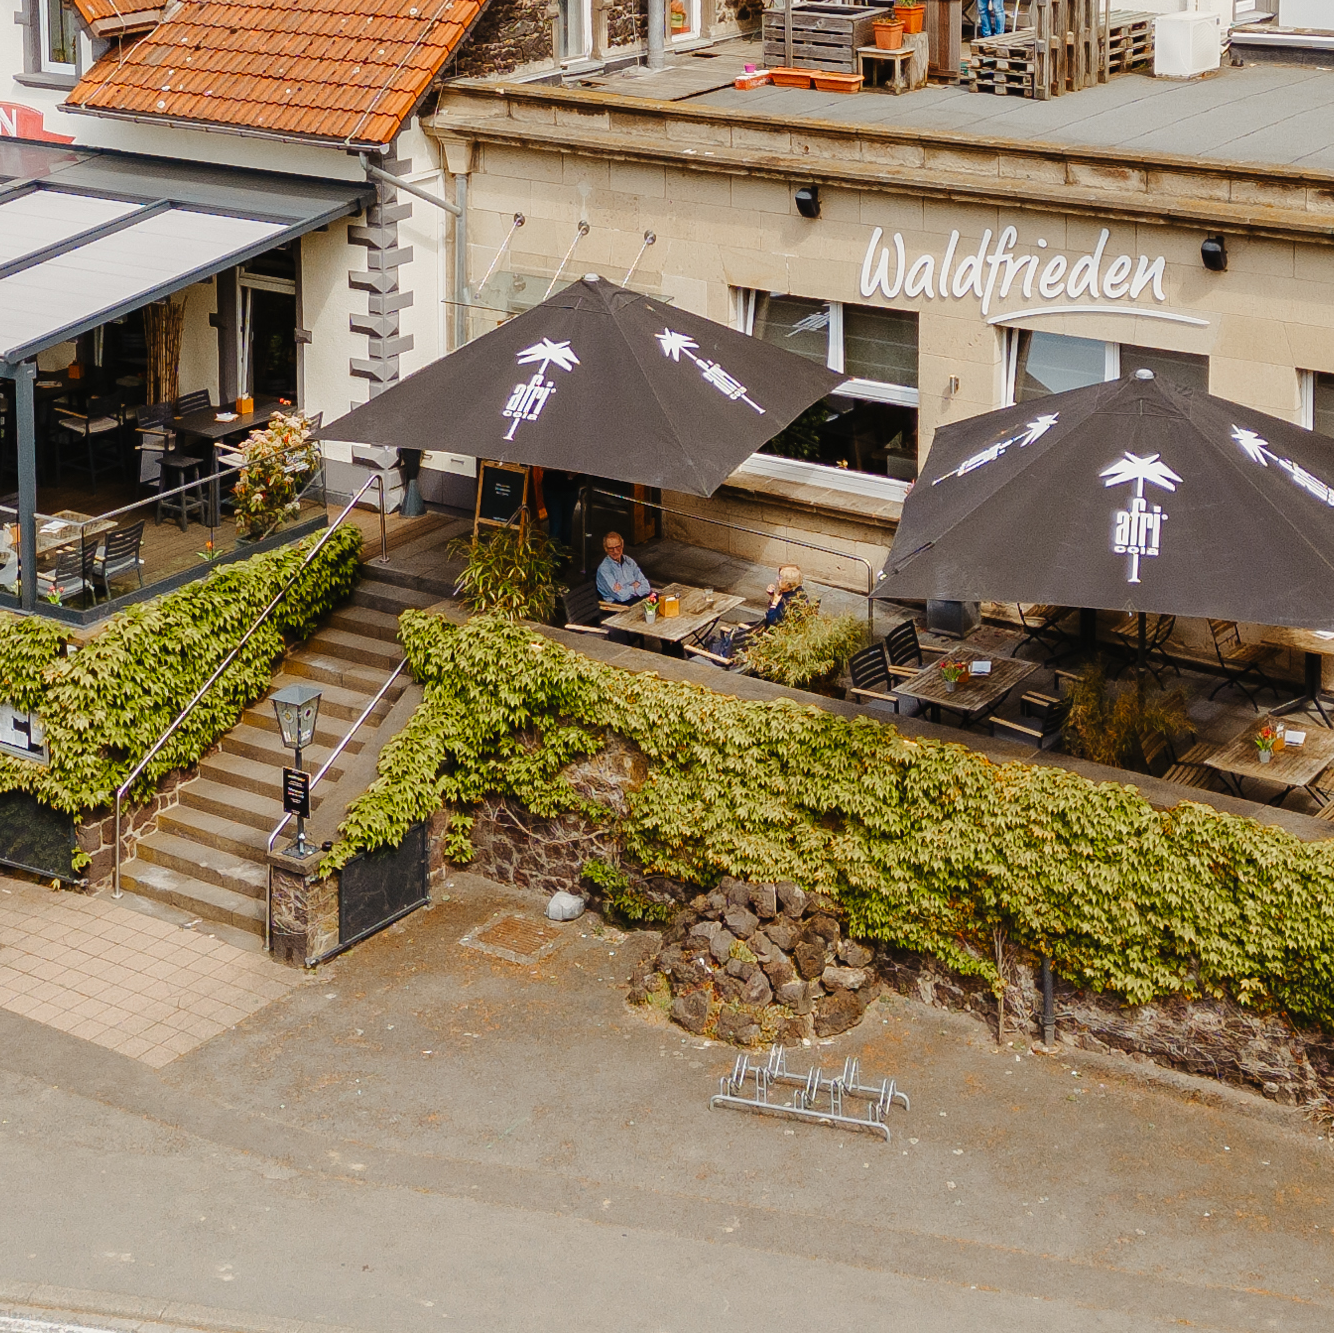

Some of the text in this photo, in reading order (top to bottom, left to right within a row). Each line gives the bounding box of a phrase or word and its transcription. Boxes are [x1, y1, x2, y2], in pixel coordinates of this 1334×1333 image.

[860, 225, 1166, 315] Waldfrieden
[506, 374, 555, 415] afri
[1115, 498, 1162, 548] afri
